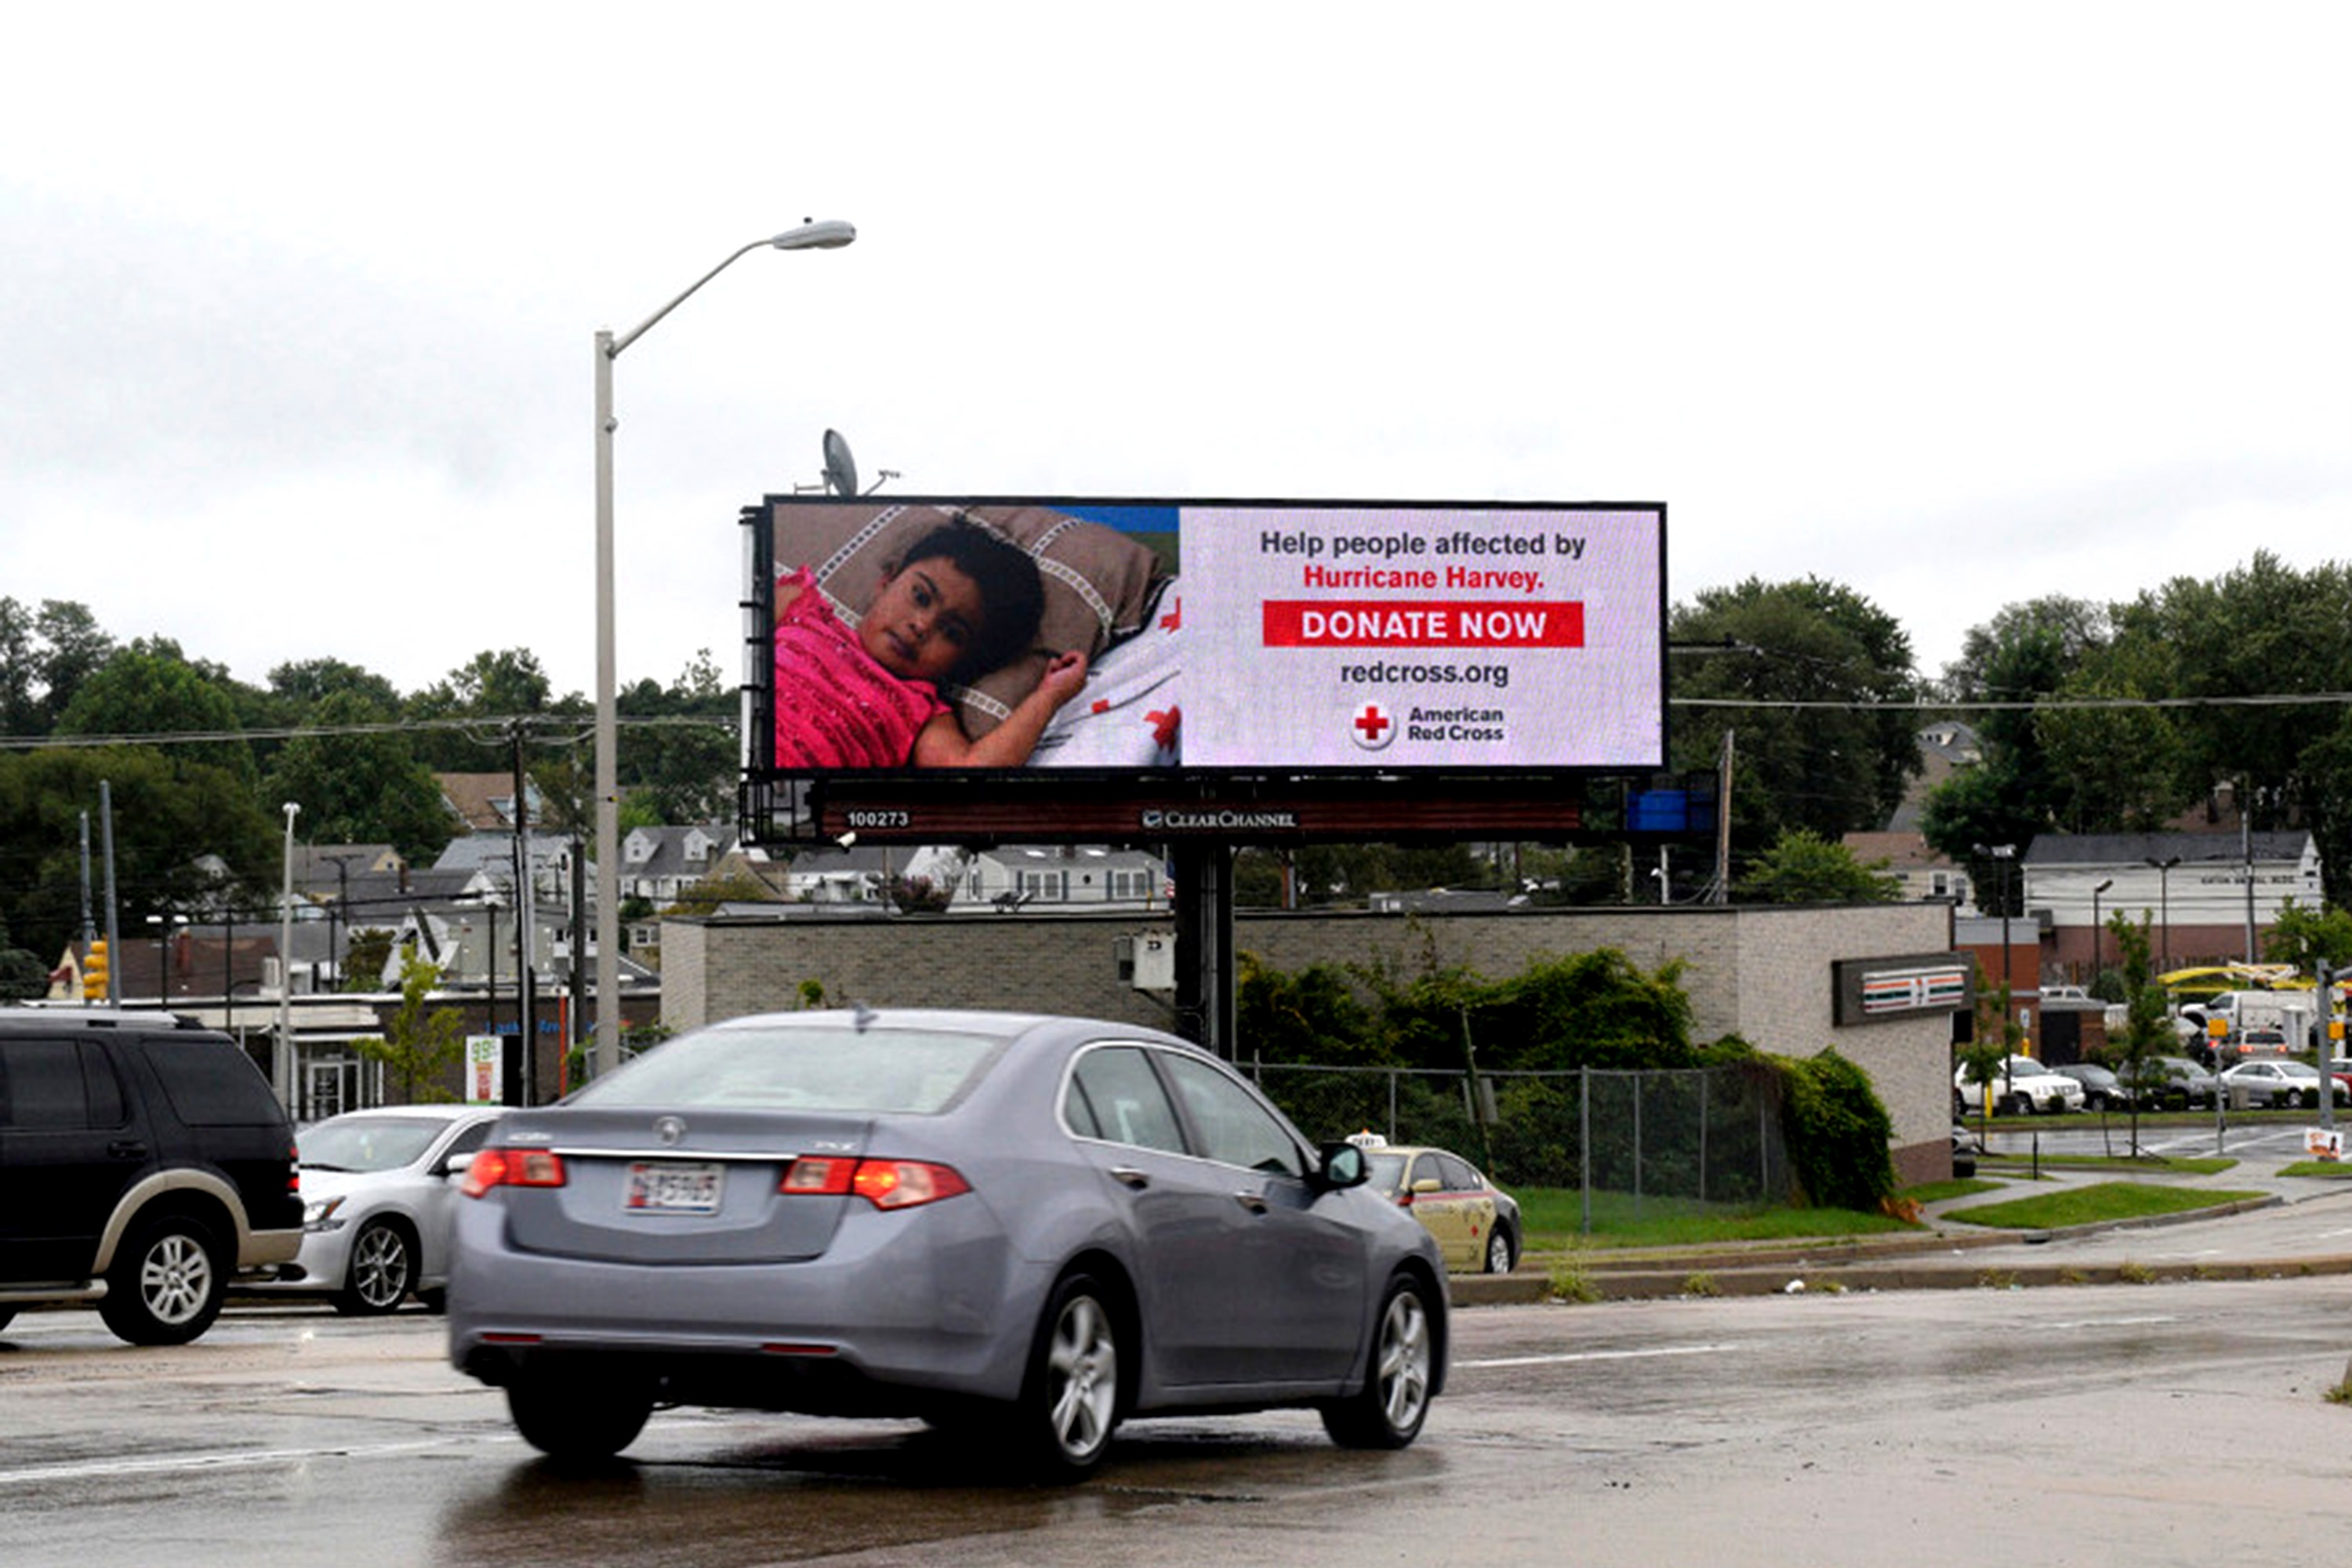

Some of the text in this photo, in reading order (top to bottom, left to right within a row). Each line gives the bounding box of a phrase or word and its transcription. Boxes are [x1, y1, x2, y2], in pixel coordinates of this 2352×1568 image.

[1261, 531, 1585, 560] Help people affected by
[1304, 564, 1544, 593] Hurricane Harvey.
[1301, 612, 1547, 639] DONATE NOW
[1341, 661, 1508, 688] redcross.org
[1409, 707, 1504, 722] American
[1408, 725, 1504, 740] Red Cross
[848, 811, 909, 827] 100273
